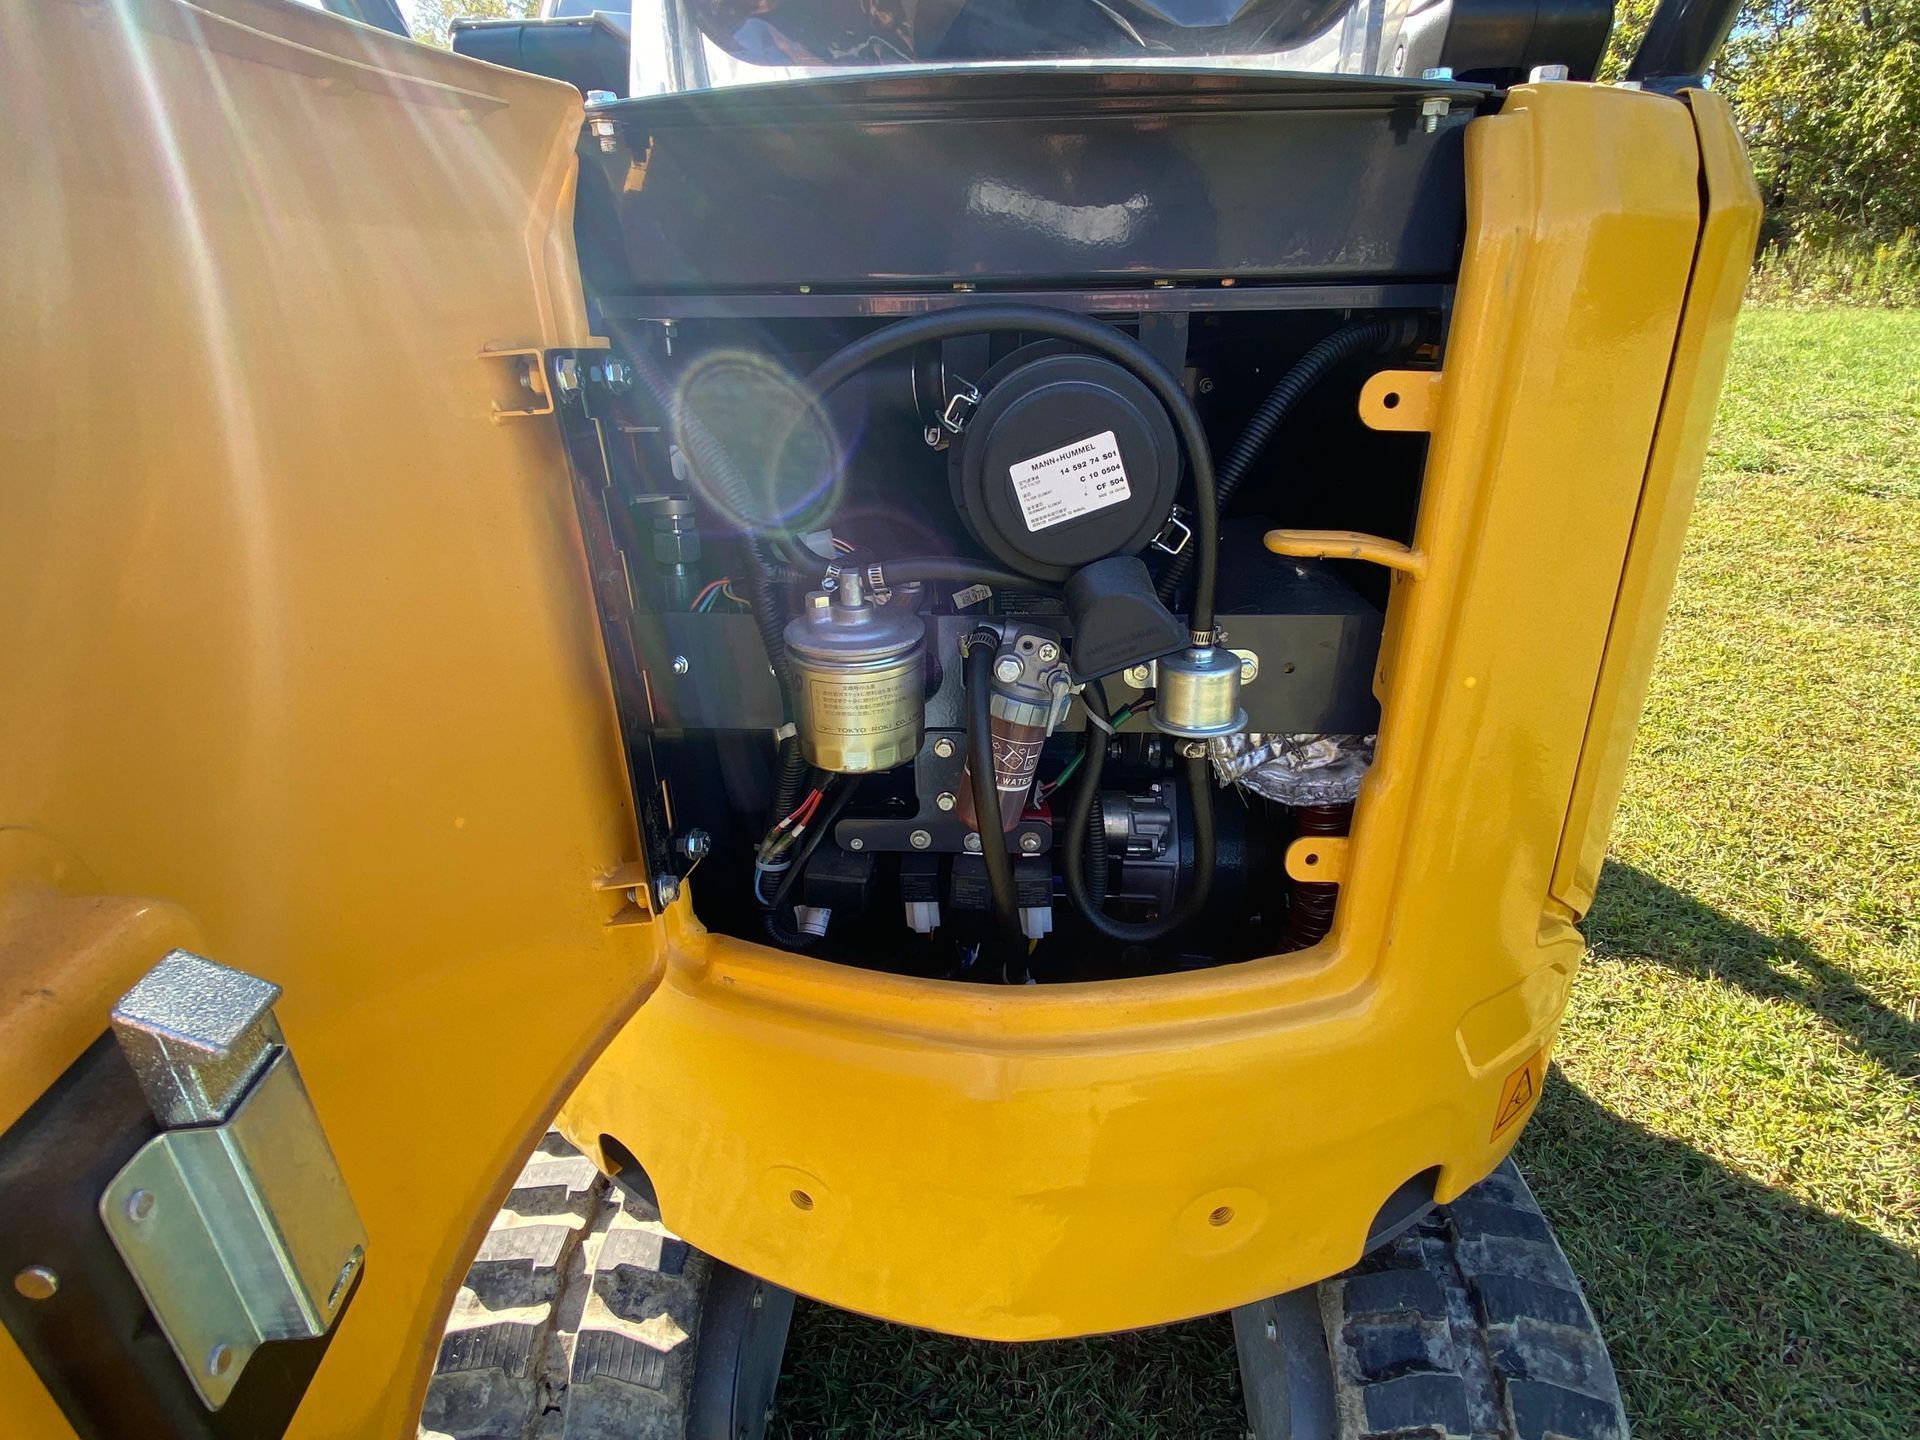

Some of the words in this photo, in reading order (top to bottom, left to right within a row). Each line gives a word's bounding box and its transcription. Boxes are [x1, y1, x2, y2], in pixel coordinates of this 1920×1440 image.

[1031, 443, 1096, 471] MANN+HUMMEL
[1060, 467, 1070, 475] 14
[1072, 462, 1088, 472] 592
[1090, 456, 1100, 465] 74
[1089, 471, 1099, 479] 10
[1101, 463, 1121, 475] 0504
[1096, 482, 1107, 491] CF
[1110, 476, 1124, 486] 504
[871, 723, 892, 732] ROKI
